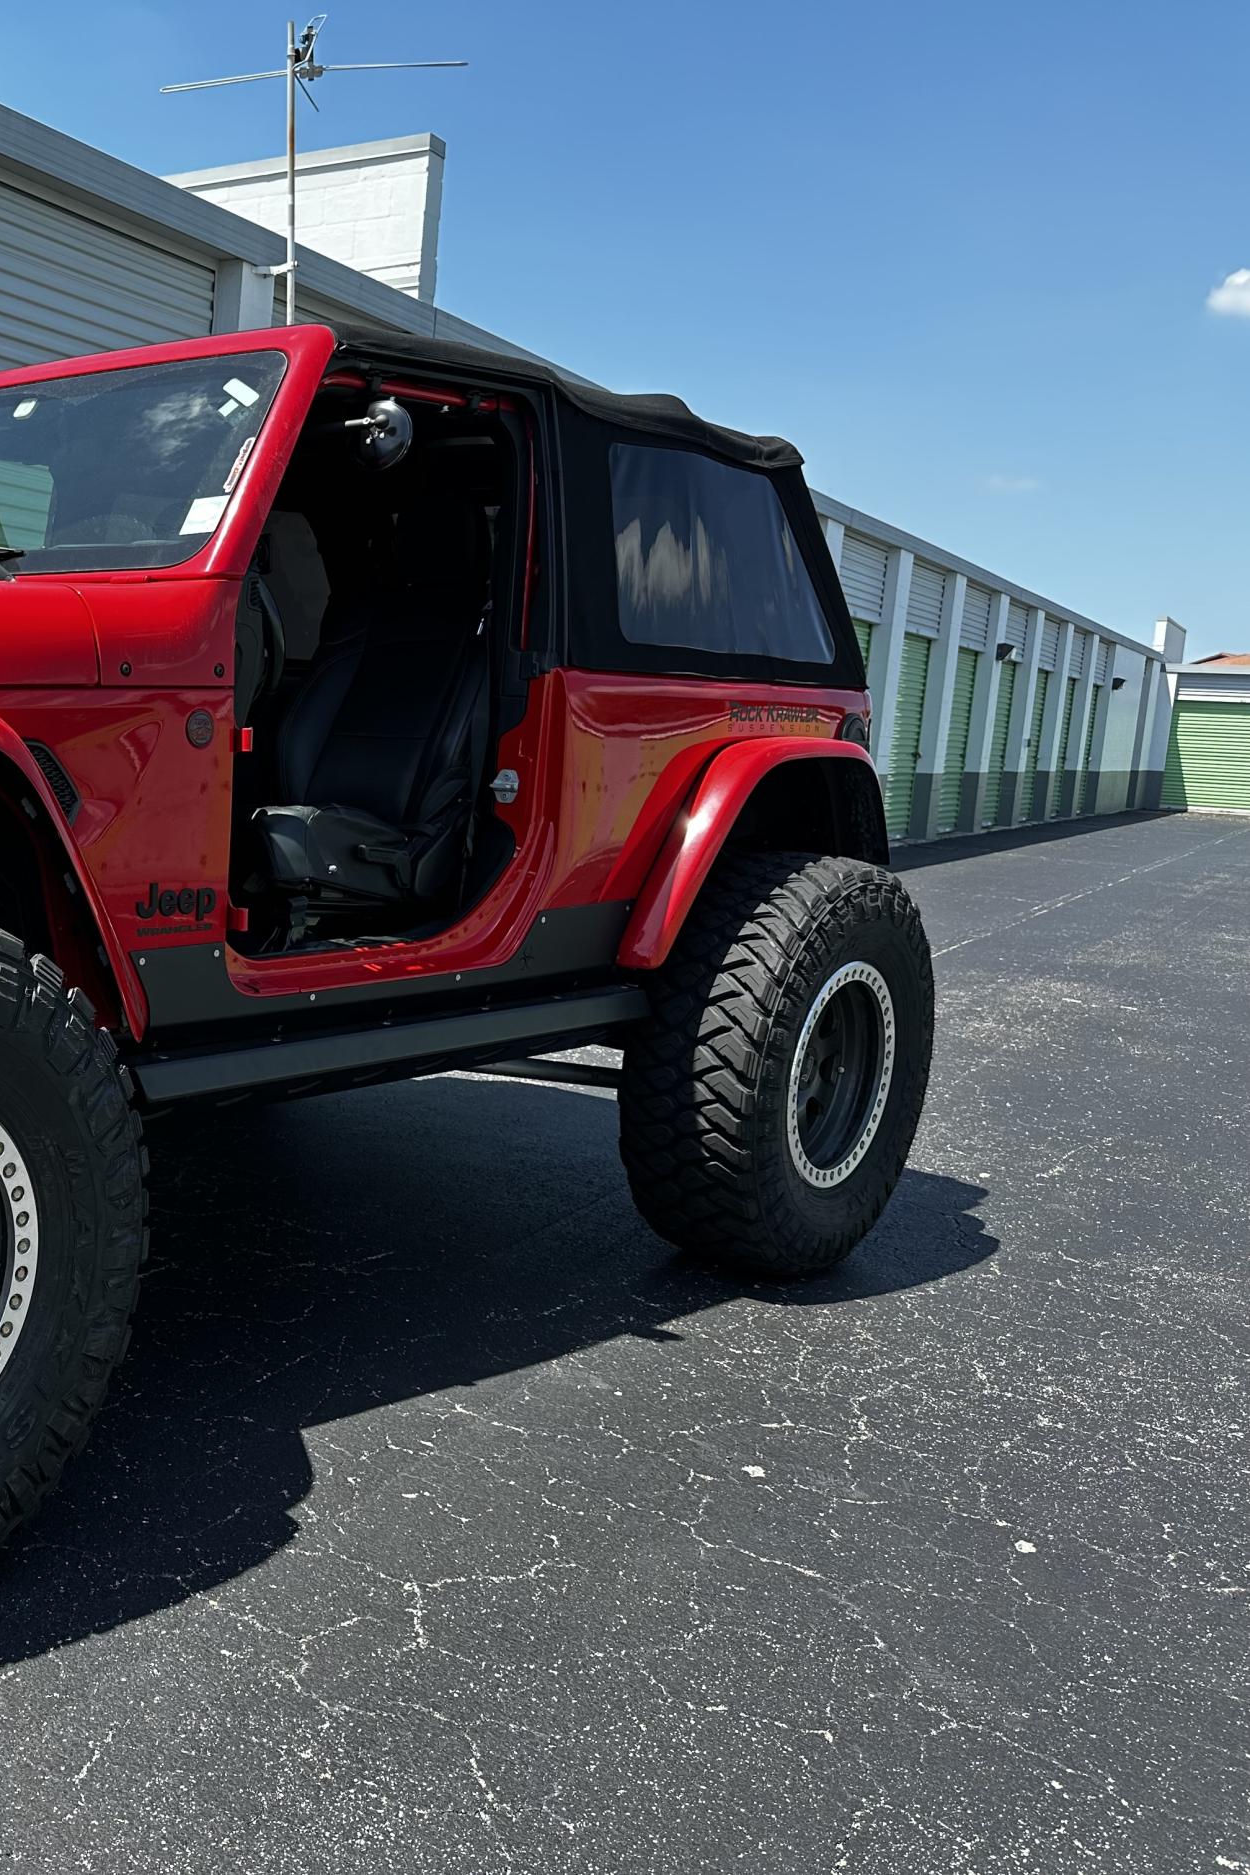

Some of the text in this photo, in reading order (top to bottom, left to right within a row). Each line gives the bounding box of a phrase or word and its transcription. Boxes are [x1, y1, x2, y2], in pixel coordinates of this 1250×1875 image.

[727, 724, 820, 732] SUSPENSION
[135, 883, 216, 921] Jeep
[136, 923, 212, 937] WRANGLER
